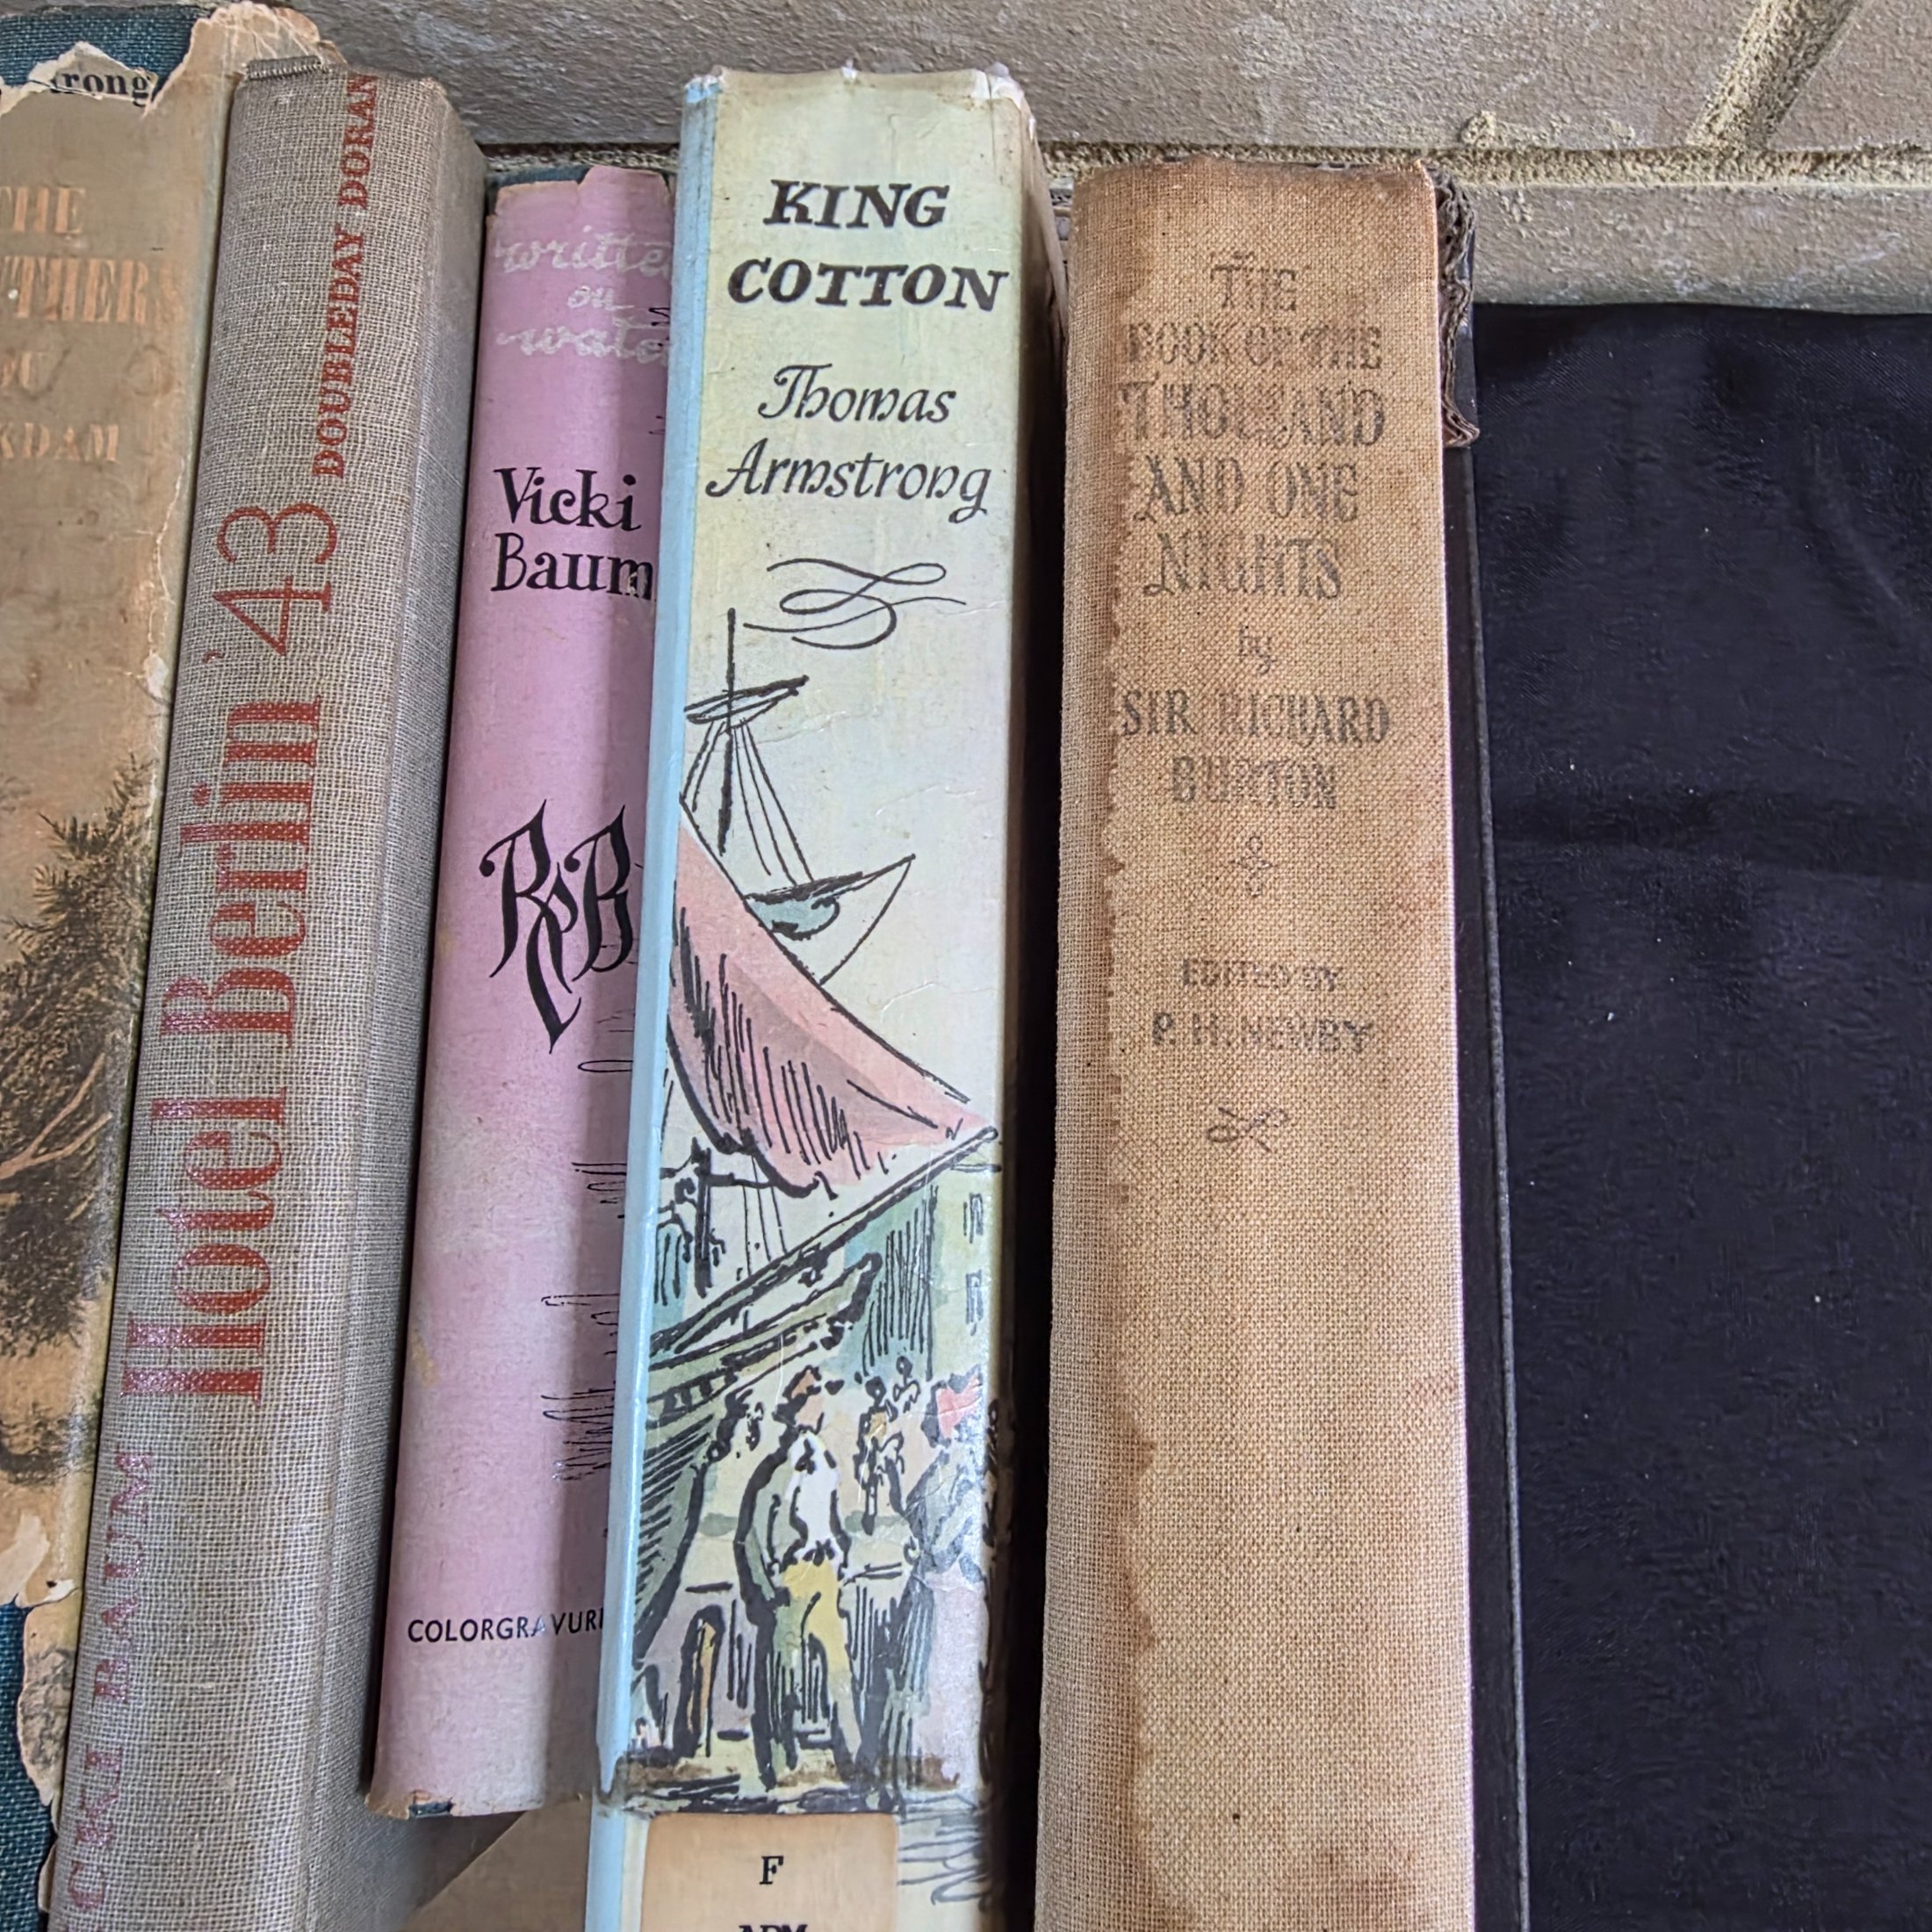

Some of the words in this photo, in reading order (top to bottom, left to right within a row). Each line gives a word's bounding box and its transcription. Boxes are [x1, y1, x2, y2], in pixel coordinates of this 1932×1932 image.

[50, 72, 150, 107] rong
[337, 73, 378, 210] DORAN
[763, 178, 949, 228] KING
[728, 257, 1010, 312] COTTON
[312, 224, 365, 479] DOUBLEDAY
[758, 363, 957, 423] Thomas
[494, 468, 642, 531] Vicki
[705, 437, 993, 523] Armstrong
[1133, 455, 1246, 523] AND
[1265, 459, 1360, 524] ONE
[491, 532, 654, 601] Baum
[1142, 530, 1344, 601] NIGHTS
[1122, 688, 1198, 738] SIR
[160, 695, 321, 1048] Berlin
[120, 1086, 286, 1405] Hotel
[759, 1855, 784, 1885] F
